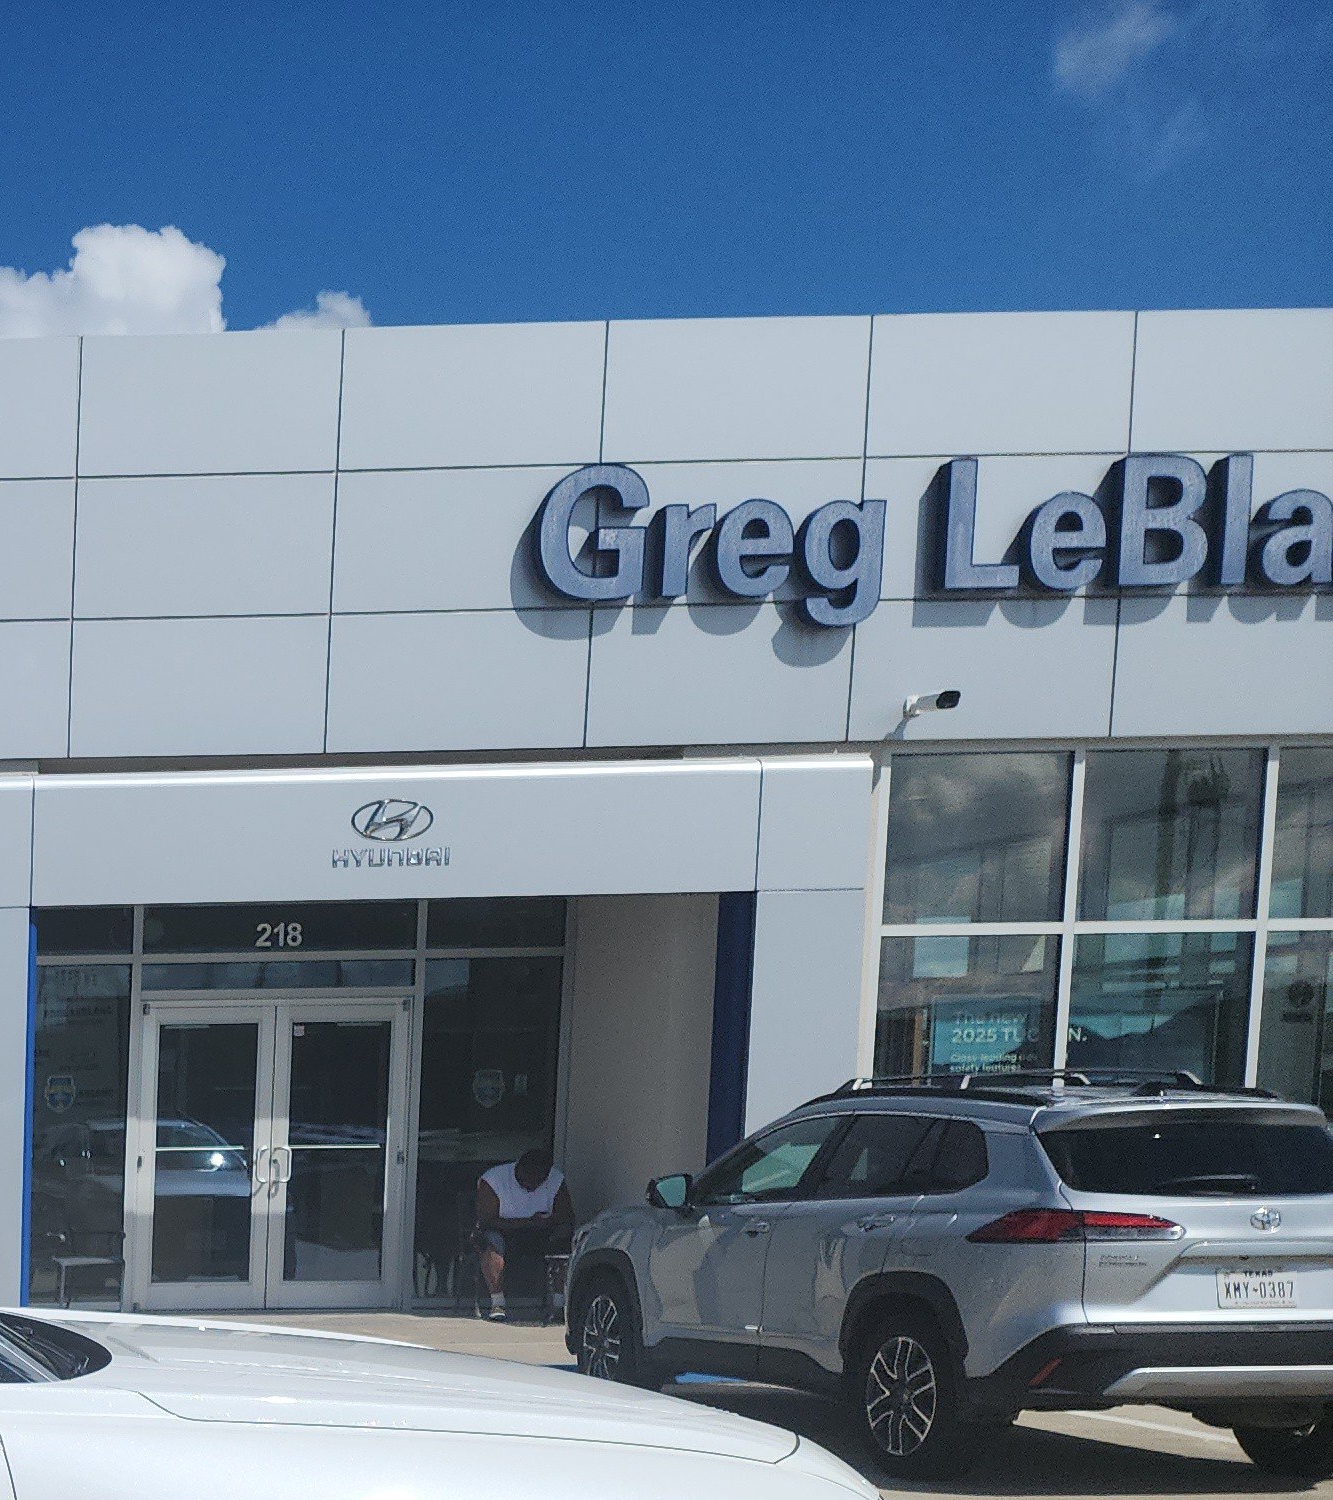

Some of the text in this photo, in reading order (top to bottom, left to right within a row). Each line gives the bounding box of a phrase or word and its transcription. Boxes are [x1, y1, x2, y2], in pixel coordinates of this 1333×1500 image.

[538, 452, 1333, 629] Greg LeBla
[331, 846, 451, 868] HYUNDAI
[254, 922, 303, 948] 218
[951, 1027, 998, 1044] 2025
